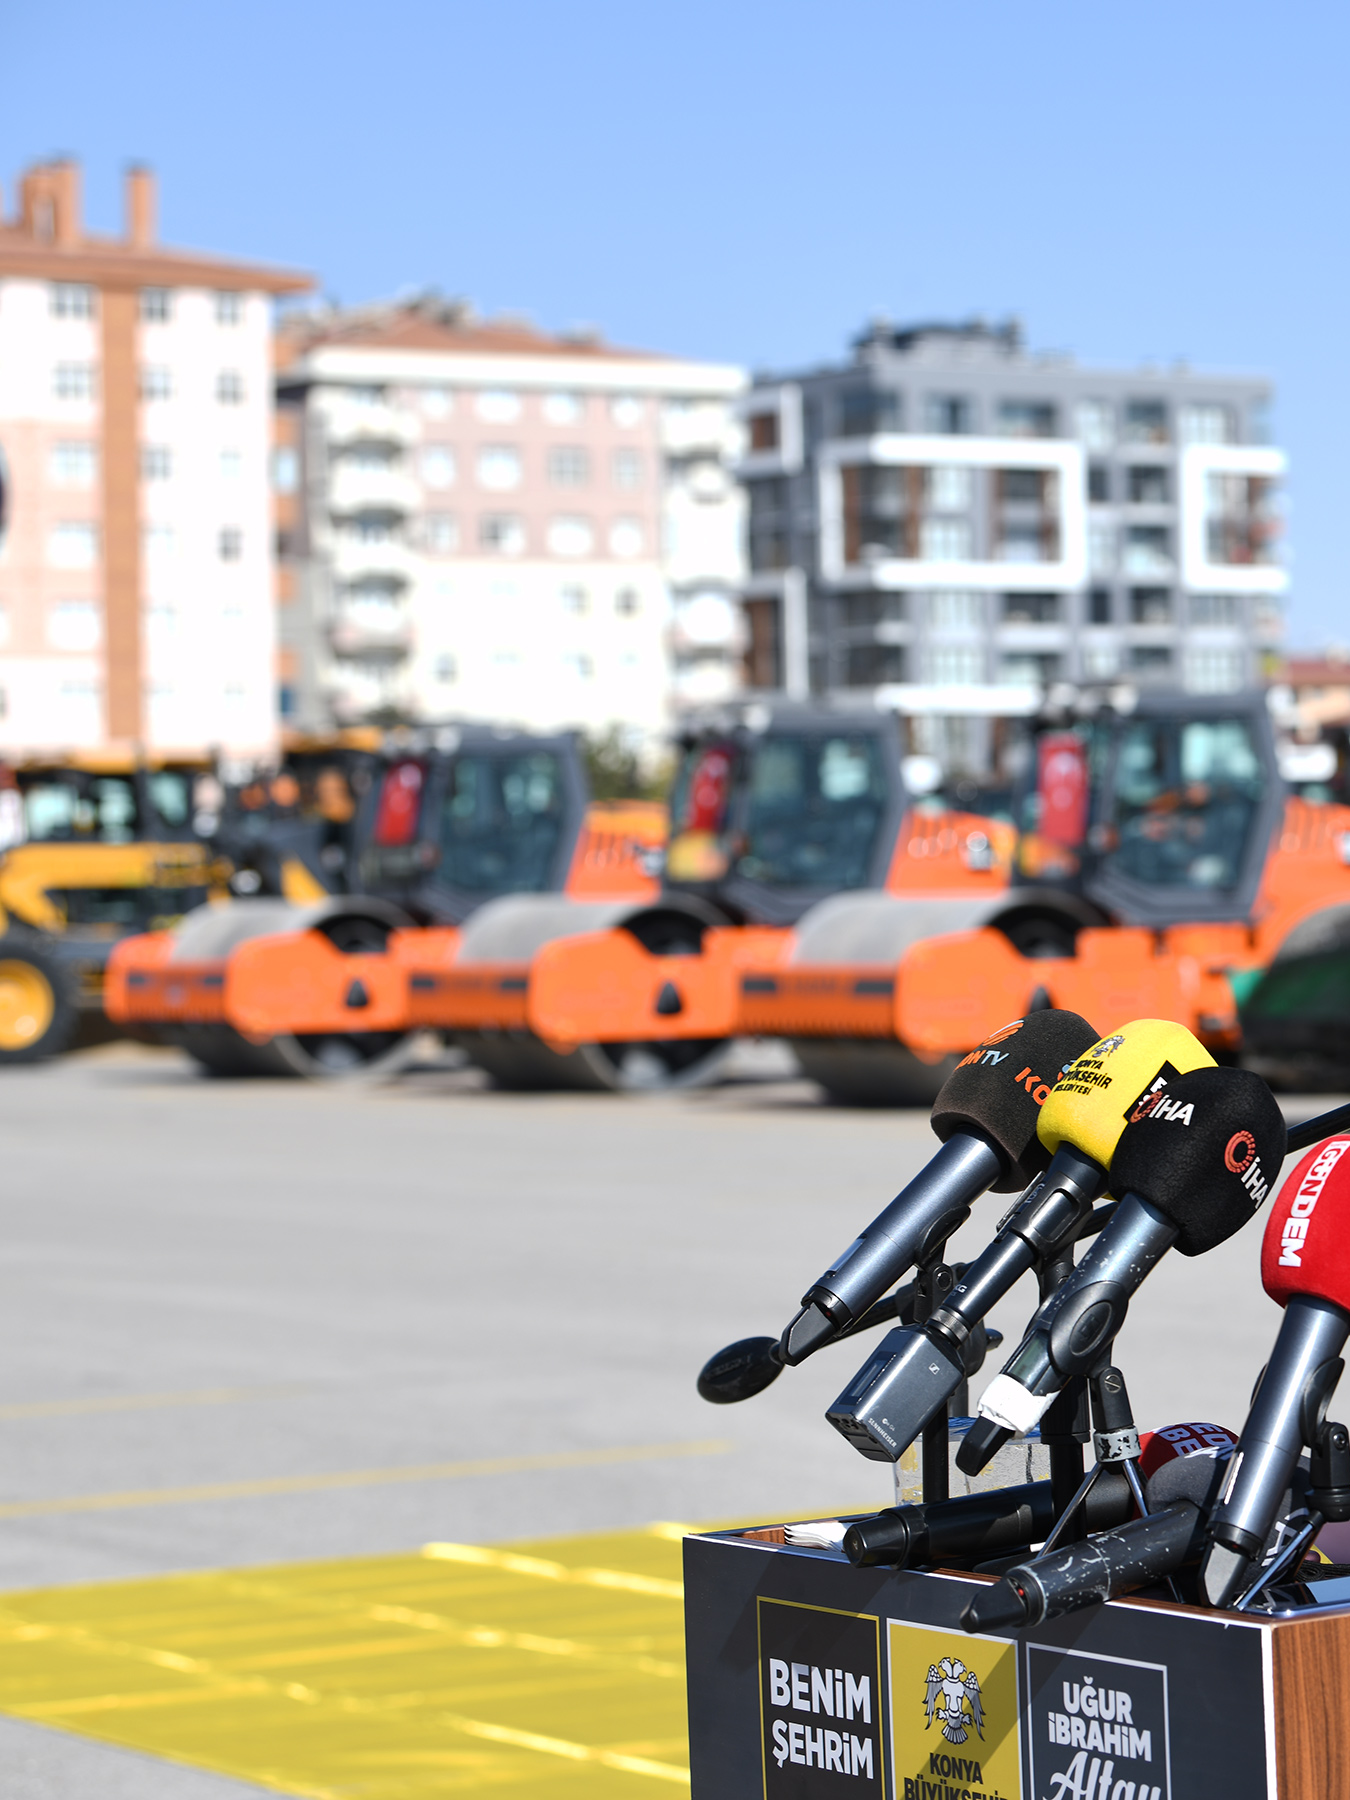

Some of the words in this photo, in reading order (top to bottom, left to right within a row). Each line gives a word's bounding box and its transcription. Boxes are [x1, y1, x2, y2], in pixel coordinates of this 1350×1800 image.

[1278, 1147, 1344, 1267] GÜNDEM
[1063, 1675, 1134, 1725] UĞUR
[929, 1752, 984, 1785] KONYA
